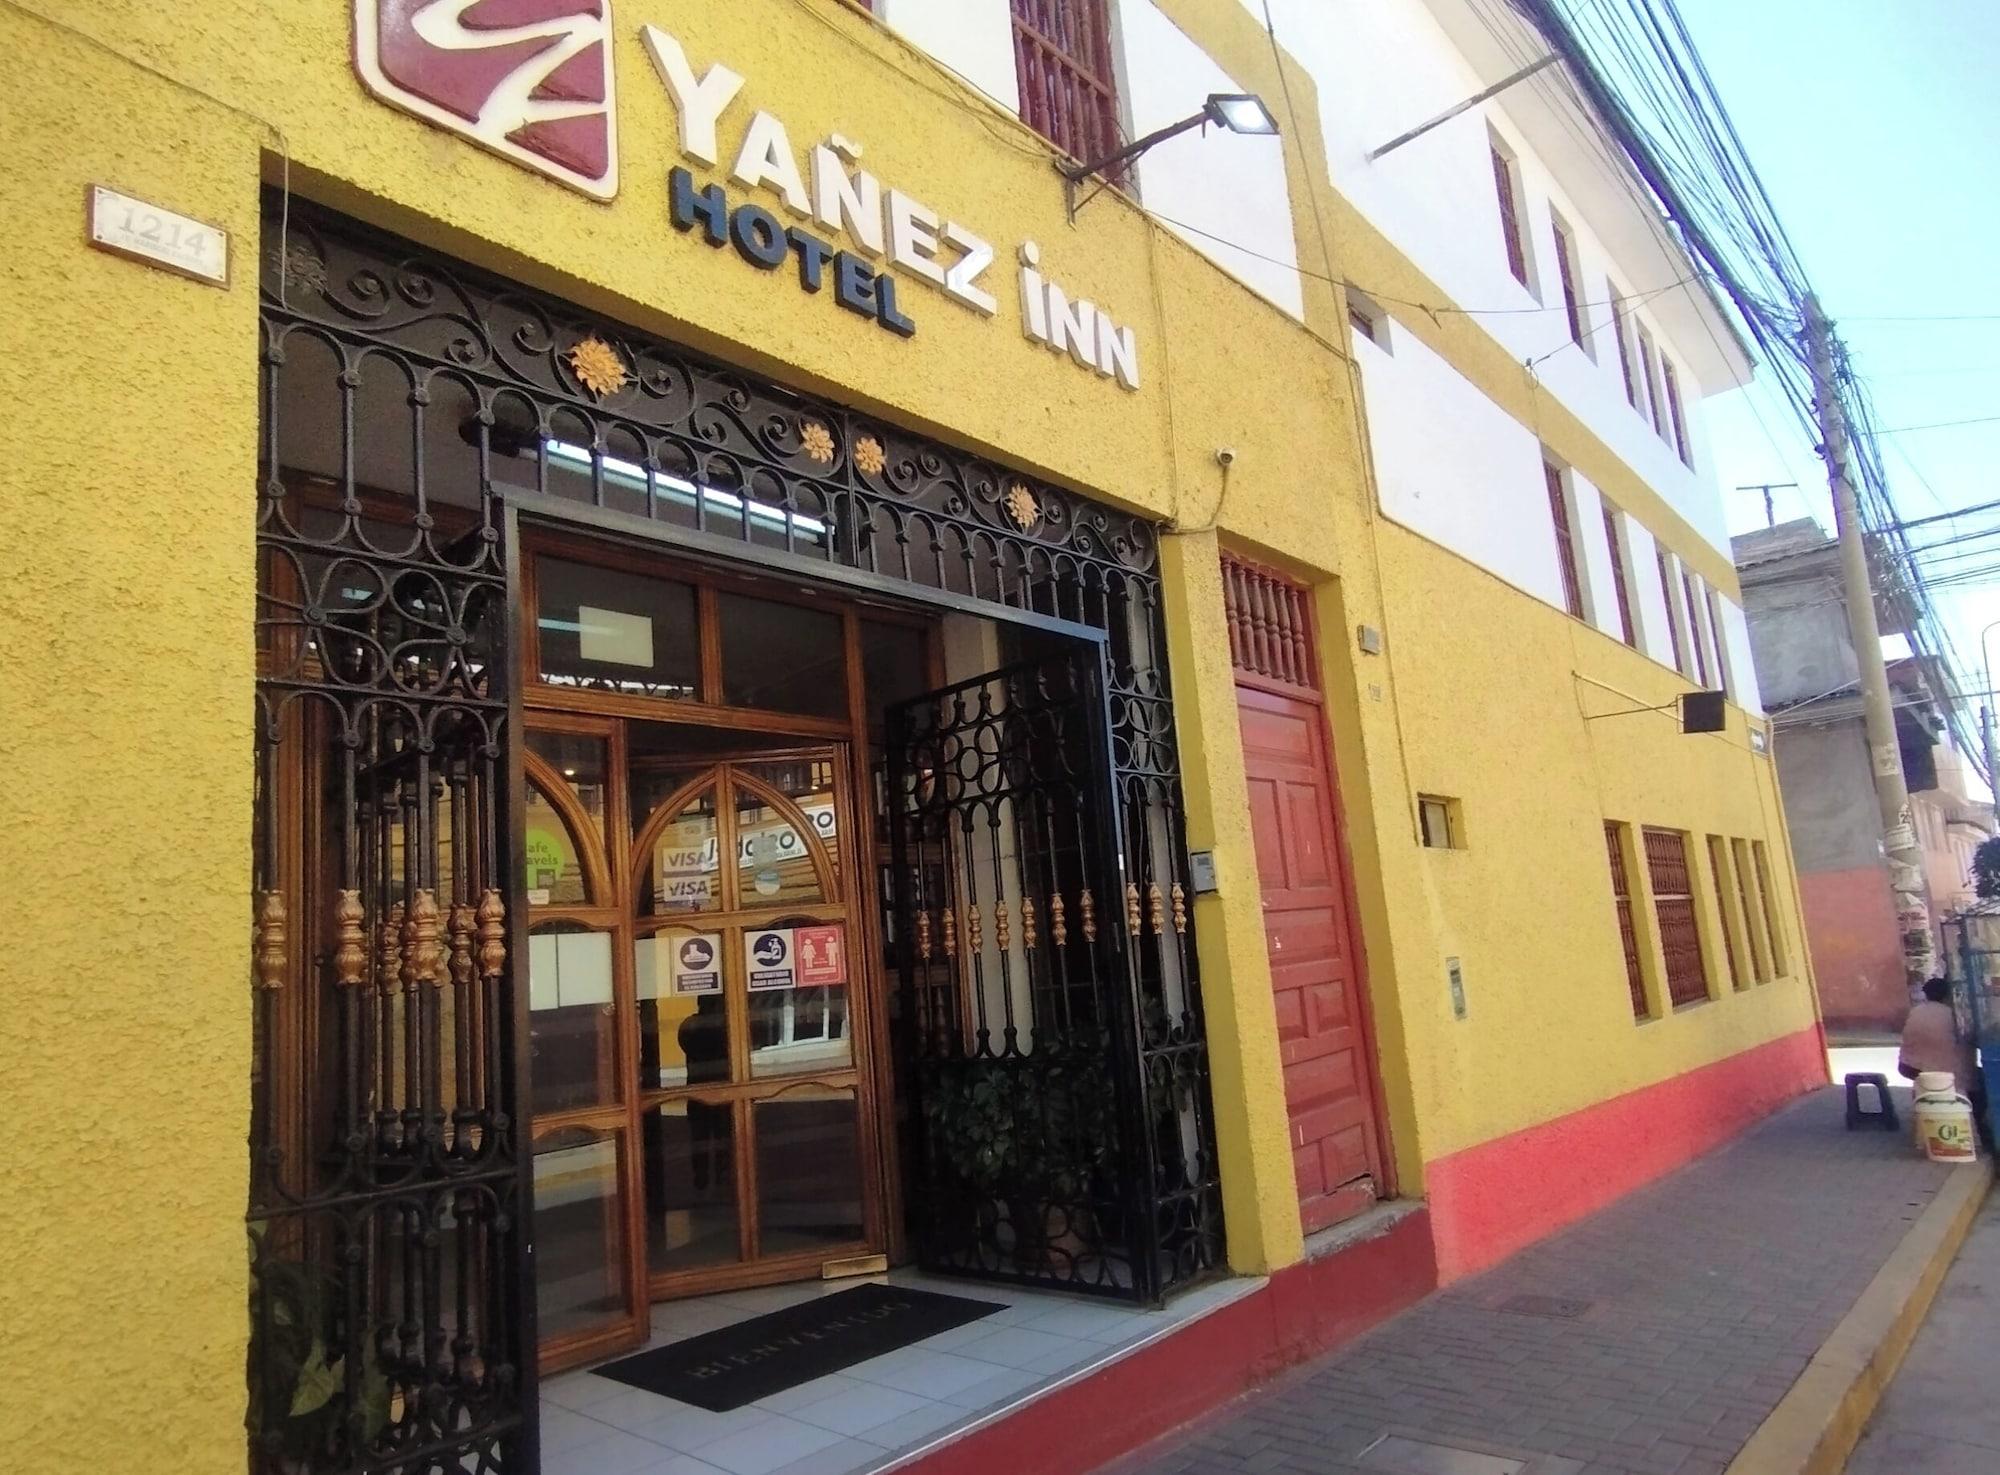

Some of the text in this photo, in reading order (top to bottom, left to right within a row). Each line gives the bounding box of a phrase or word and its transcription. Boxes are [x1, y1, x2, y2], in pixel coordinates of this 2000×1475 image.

[639, 23, 997, 319] YAÑEZ
[119, 208, 206, 257] 1214
[669, 165, 916, 338] HOTEL
[528, 840, 549, 854] afe
[668, 880, 709, 897] VISA
